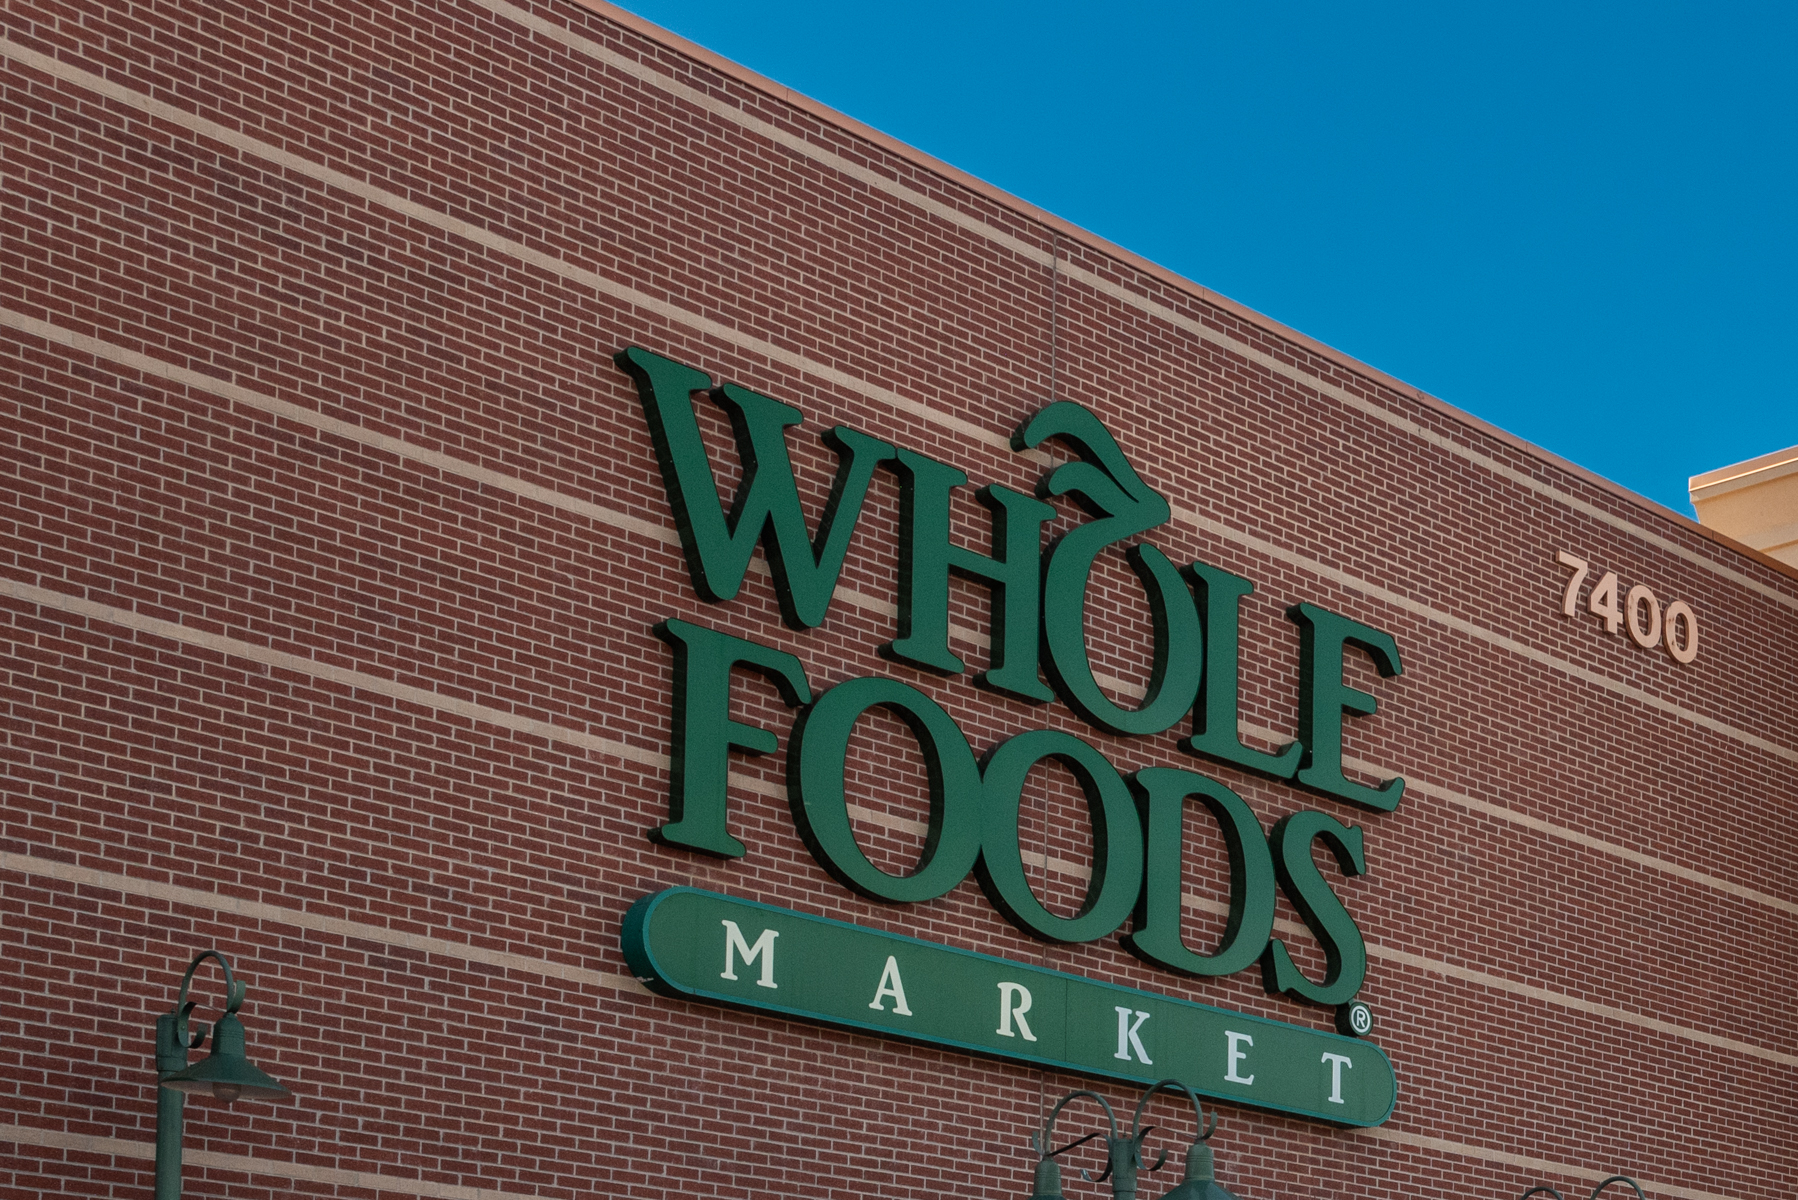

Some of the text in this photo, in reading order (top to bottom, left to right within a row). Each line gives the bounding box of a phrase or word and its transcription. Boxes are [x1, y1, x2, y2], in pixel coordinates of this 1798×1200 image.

[615, 346, 1405, 812] WHOLE
[1555, 549, 1699, 664] 7400
[648, 617, 1367, 1005] FOODS
[719, 919, 1353, 1104] MARKET
